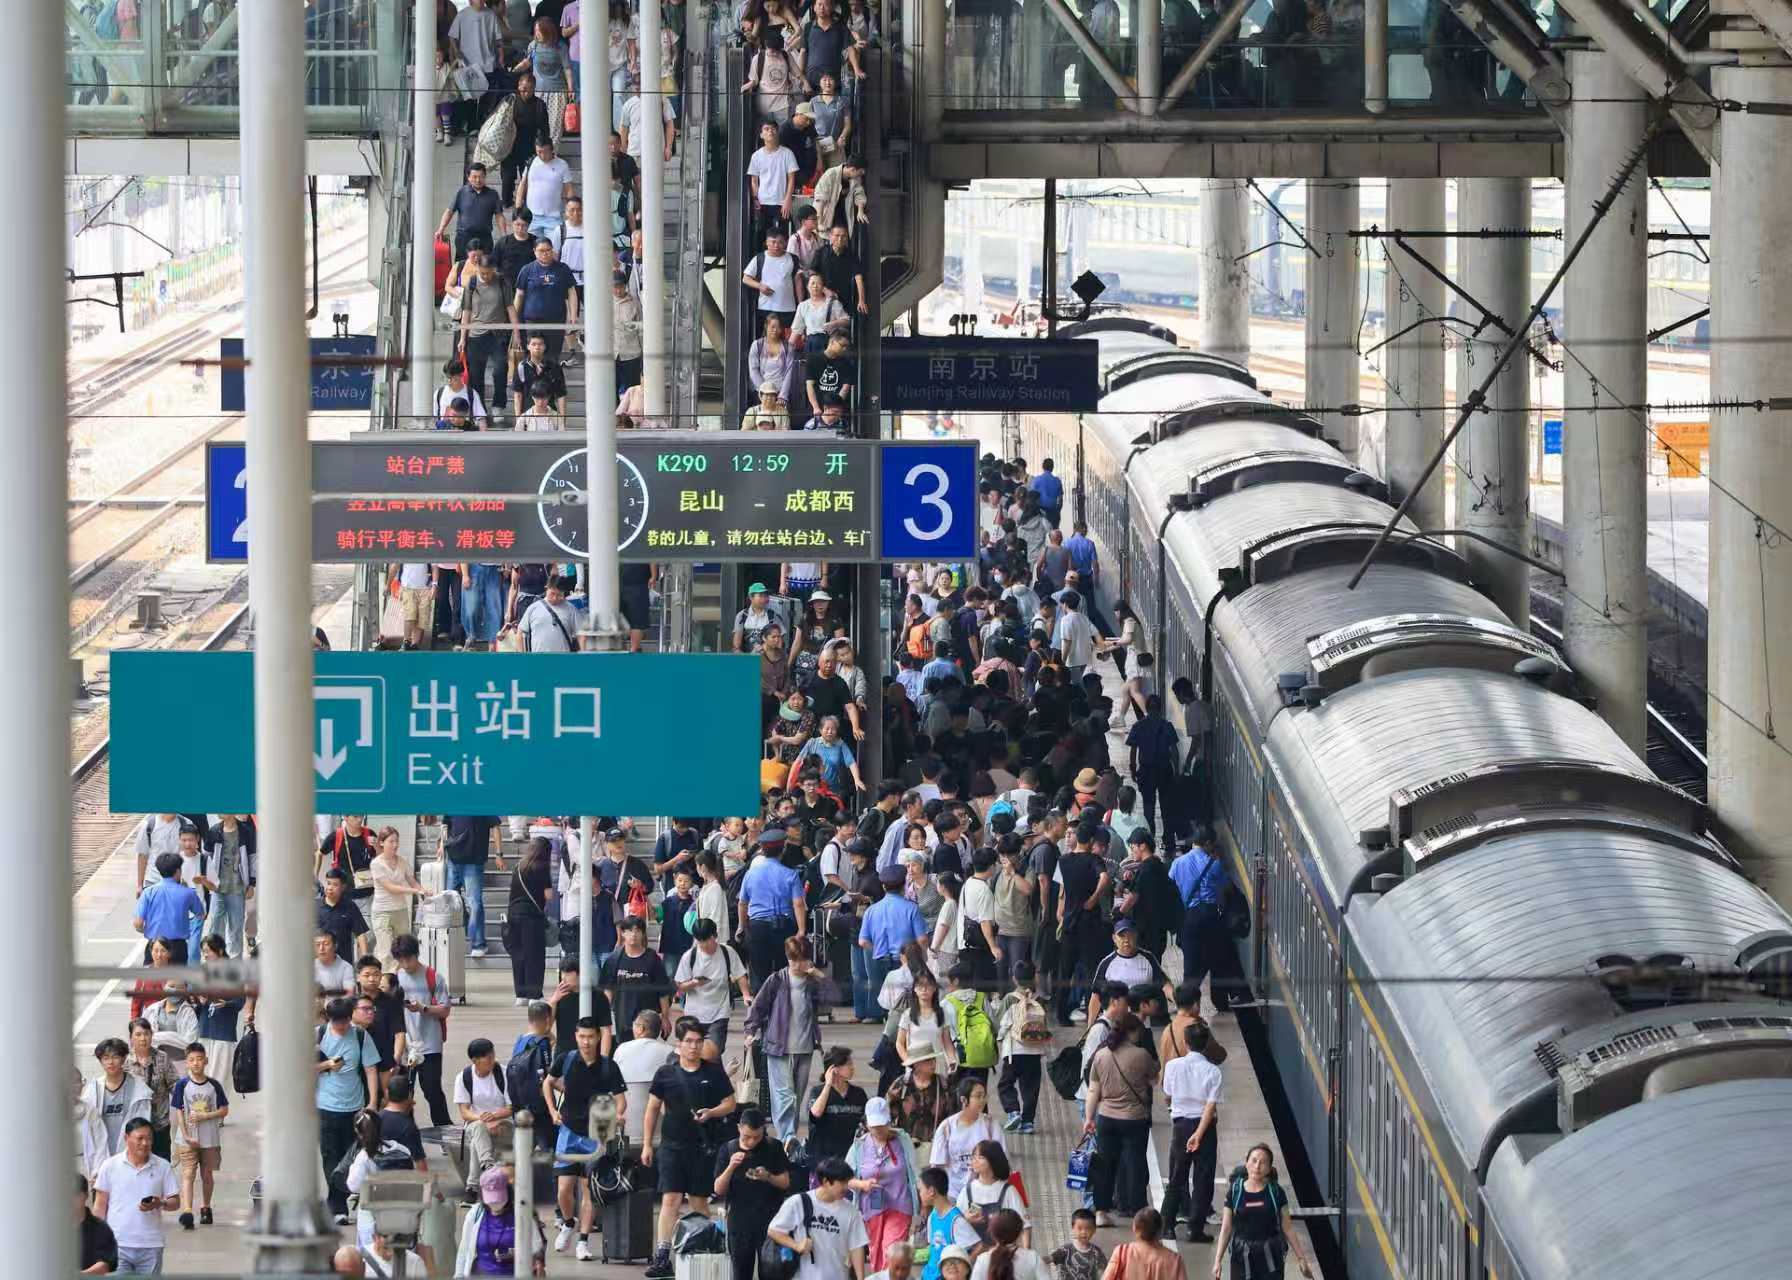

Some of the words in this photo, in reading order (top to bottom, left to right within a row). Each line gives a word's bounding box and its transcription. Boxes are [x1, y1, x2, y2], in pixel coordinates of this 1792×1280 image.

[928, 350, 1041, 381] 南京站
[958, 384, 1013, 401] Railway
[1018, 384, 1070, 401] Station
[386, 456, 465, 476] 站台严禁
[656, 454, 707, 473] K290
[732, 454, 790, 473] 12:59
[825, 453, 849, 475] 开
[679, 489, 725, 512] 昆山
[785, 489, 856, 513] 成都西
[903, 463, 954, 541] 3
[336, 529, 515, 549] 骑行平衡车、滑板等
[409, 679, 602, 742] 出站口
[408, 753, 484, 785] Exit
